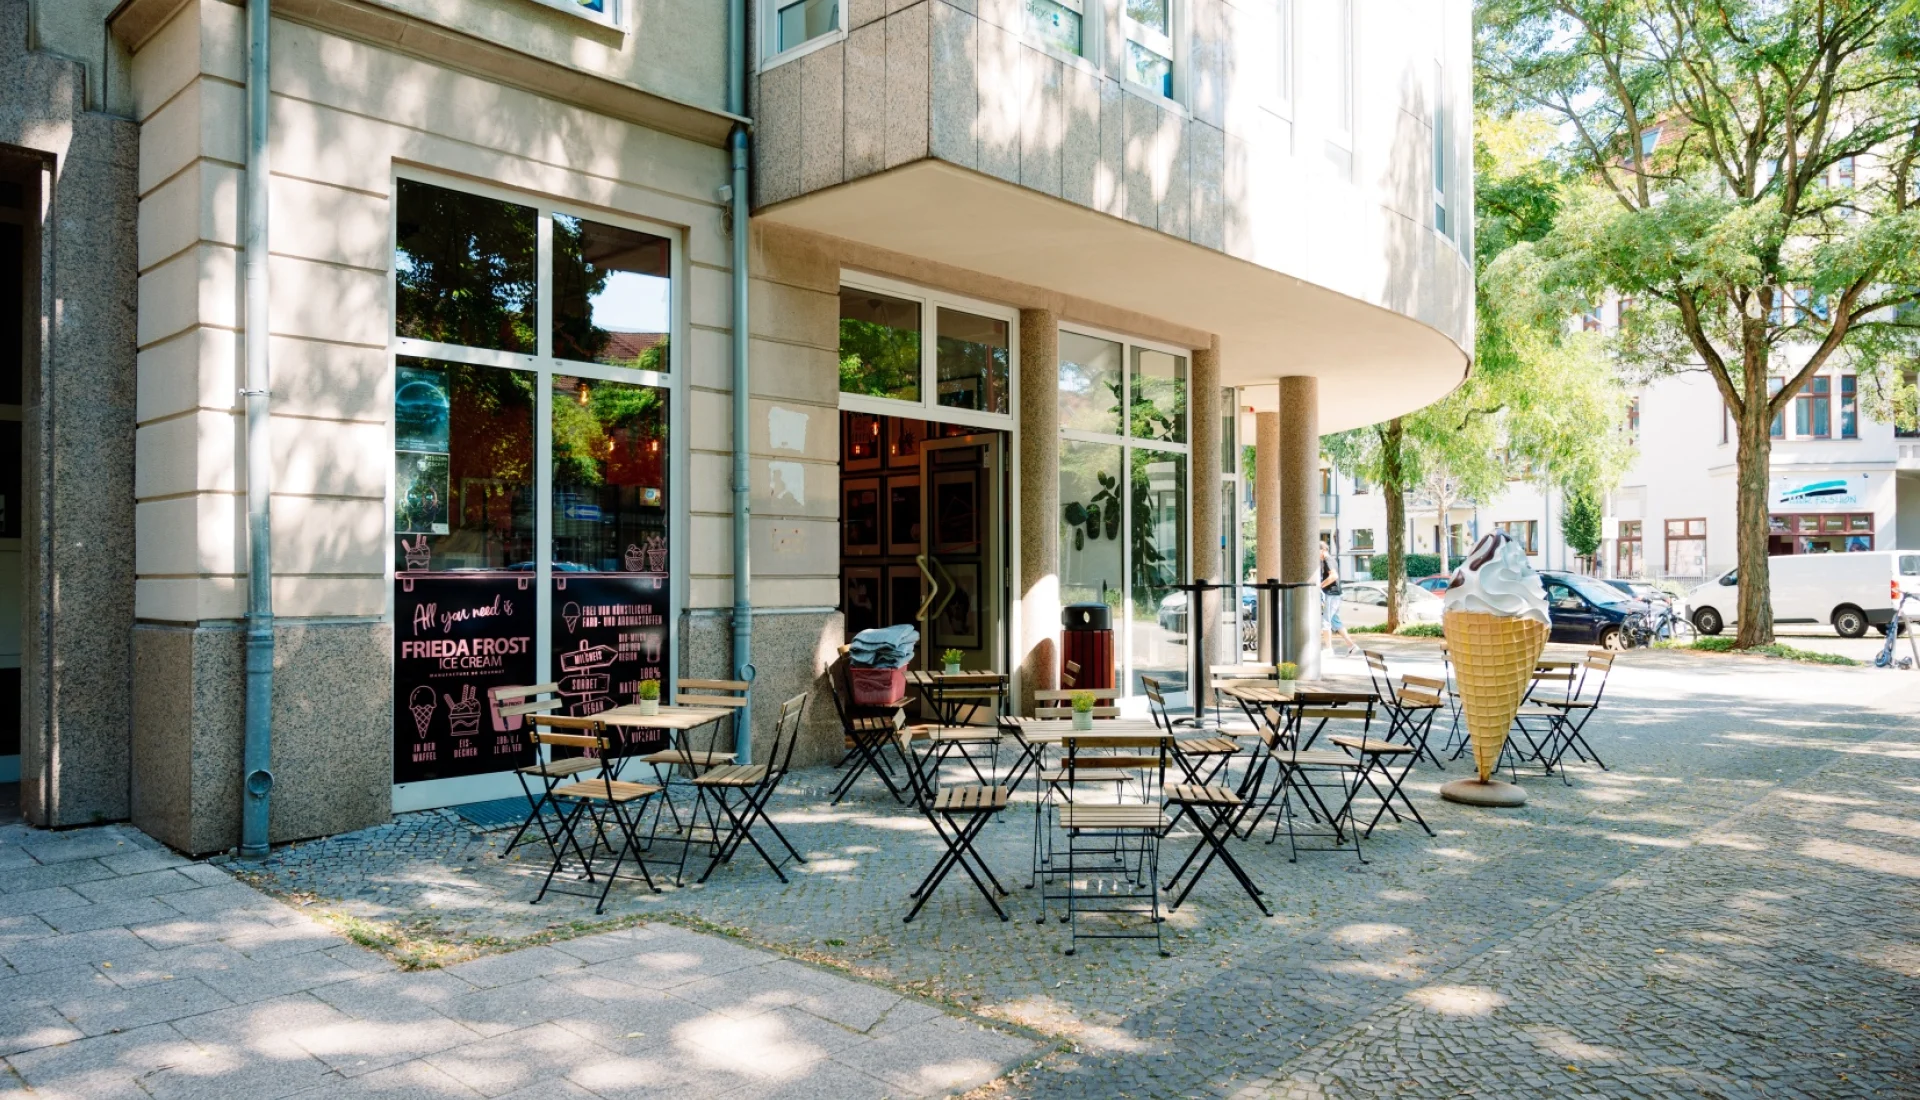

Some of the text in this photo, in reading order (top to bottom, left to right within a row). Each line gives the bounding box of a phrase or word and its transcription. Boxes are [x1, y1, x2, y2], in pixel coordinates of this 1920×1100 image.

[413, 594, 513, 636] All you need is
[401, 636, 530, 659] FRIEDA FROST
[439, 655, 502, 670] ICE CREAM
[640, 667, 661, 680] 100%
[572, 678, 597, 690] SORBET
[582, 700, 604, 715] VEGAN
[459, 738, 472, 749] EIS-
[412, 751, 437, 763] WAFFEL
